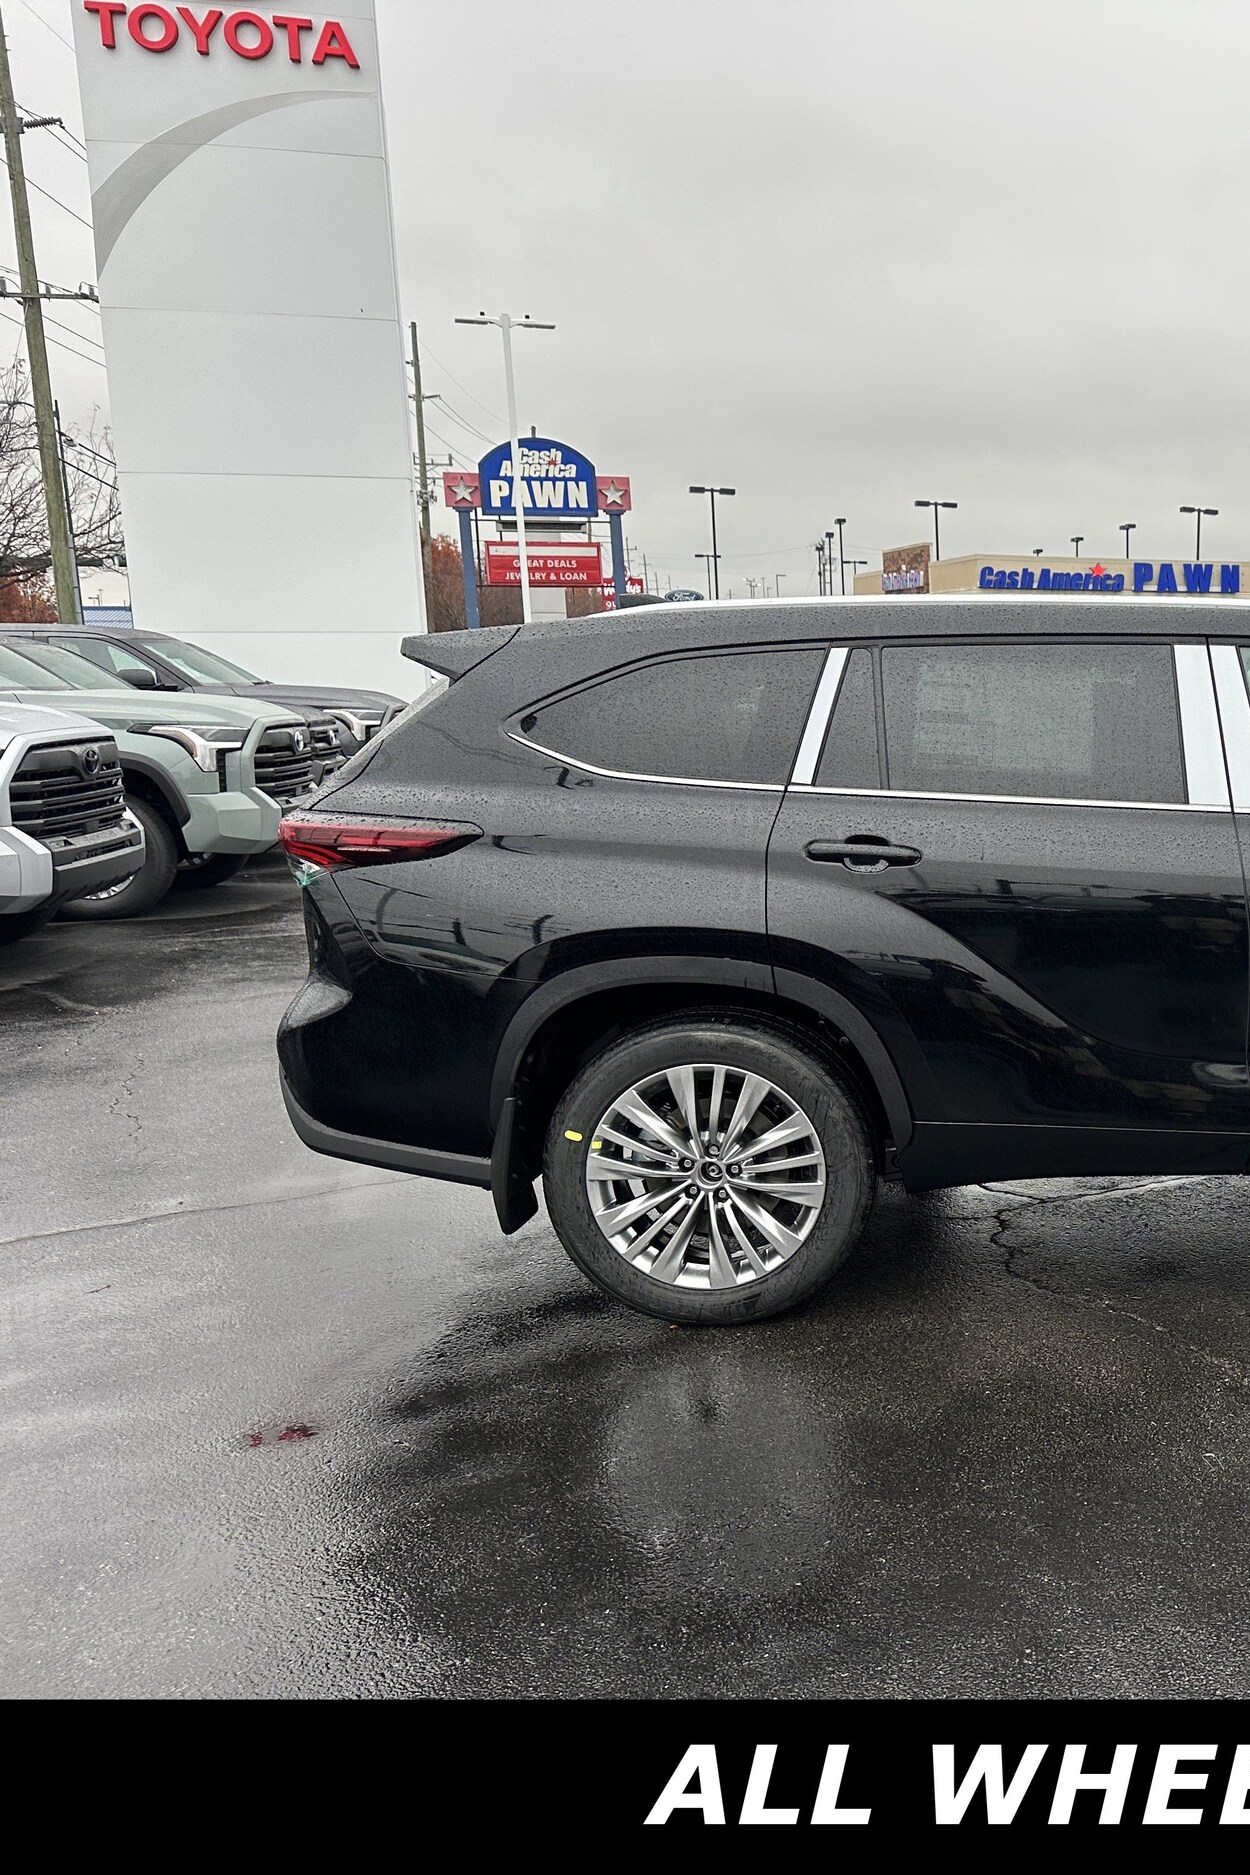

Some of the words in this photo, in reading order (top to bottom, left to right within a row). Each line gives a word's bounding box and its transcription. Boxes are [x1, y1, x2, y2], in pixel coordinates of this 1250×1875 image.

[84, 0, 361, 69] TOYOTA
[518, 447, 562, 464] Cash
[513, 560, 544, 568] GEAT
[547, 560, 577, 568] DEALS
[505, 572, 546, 580] JEWLRY
[550, 572, 557, 580] &
[560, 572, 587, 580] LOAN
[979, 566, 1035, 590] Cash
[1037, 568, 1125, 592] America
[1133, 562, 1240, 593] PAWN
